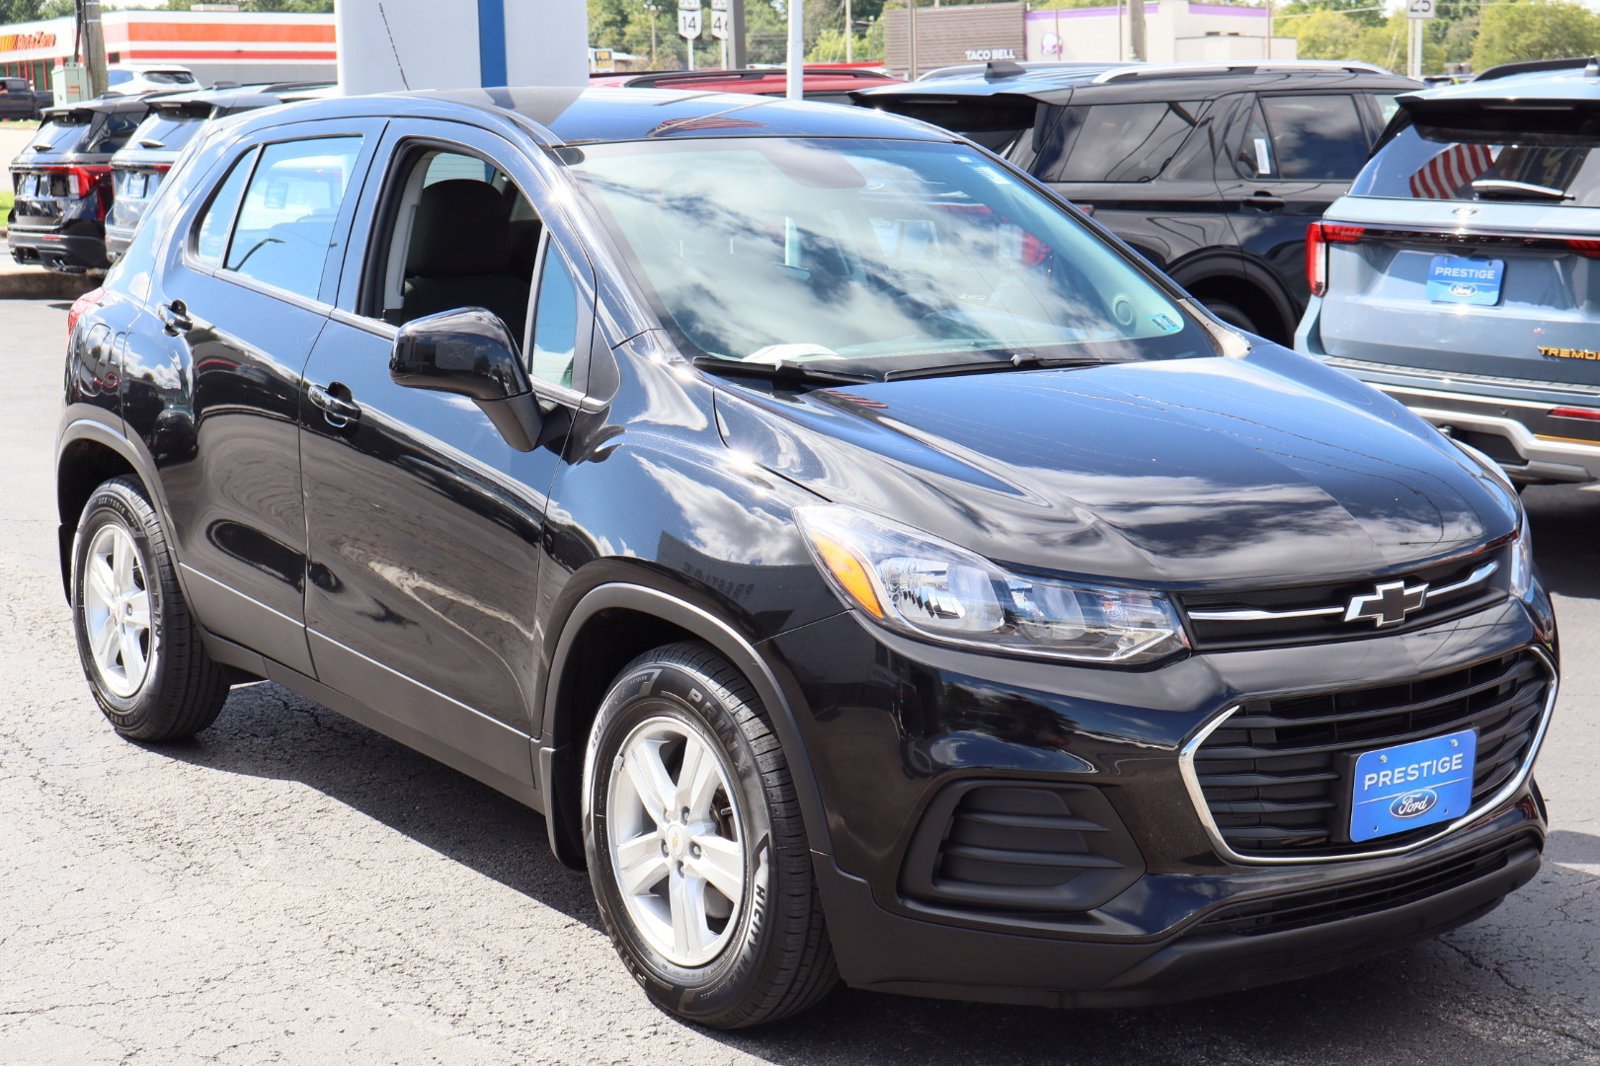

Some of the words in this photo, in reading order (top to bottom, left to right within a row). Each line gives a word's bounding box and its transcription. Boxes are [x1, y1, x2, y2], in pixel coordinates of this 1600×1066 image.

[1410, 0, 1431, 12] 25
[682, 16, 696, 32] 14
[965, 49, 991, 61] TACO
[992, 48, 1016, 60] BELL
[1434, 266, 1496, 280] PRESTIGE
[686, 687, 753, 772] PRINX
[1364, 753, 1464, 791] PRESTIGE
[1398, 793, 1429, 815] Ford
